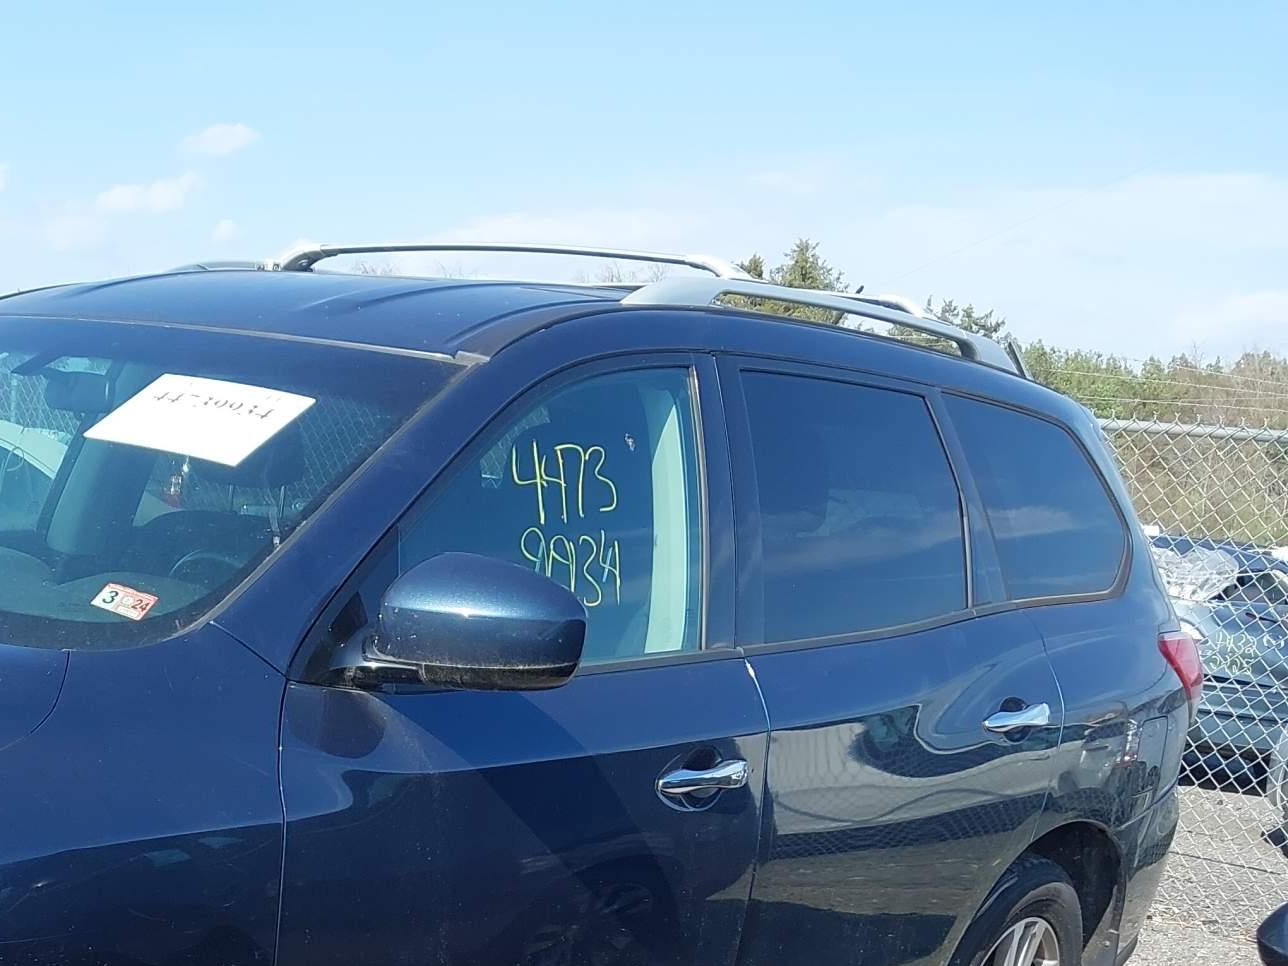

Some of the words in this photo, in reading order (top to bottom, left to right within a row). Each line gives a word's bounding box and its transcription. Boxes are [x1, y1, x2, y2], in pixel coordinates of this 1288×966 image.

[512, 439, 618, 525] 4473
[102, 590, 119, 604] 3
[131, 598, 150, 613] 24
